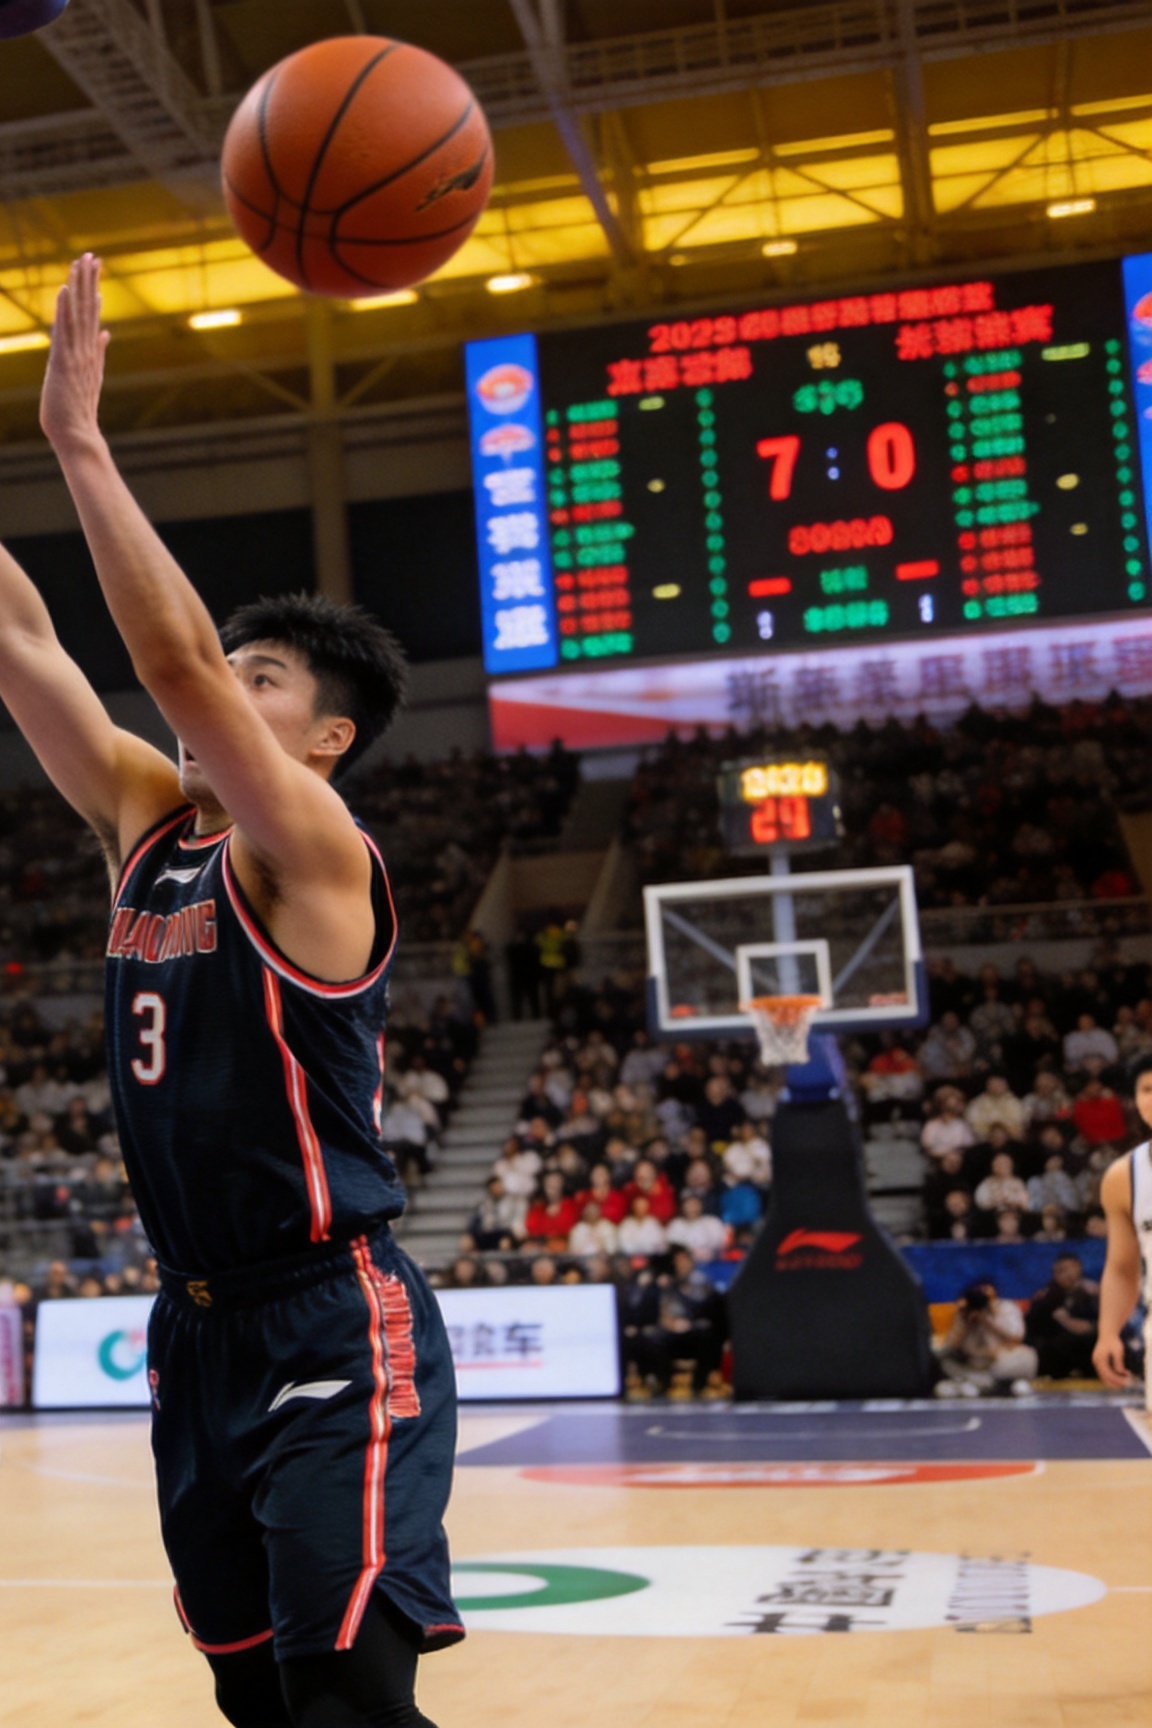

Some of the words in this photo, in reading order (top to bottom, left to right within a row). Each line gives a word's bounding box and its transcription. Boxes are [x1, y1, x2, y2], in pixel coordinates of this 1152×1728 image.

[756, 434, 800, 501] 7
[867, 421, 915, 490] 0
[130, 991, 166, 1085] 3
